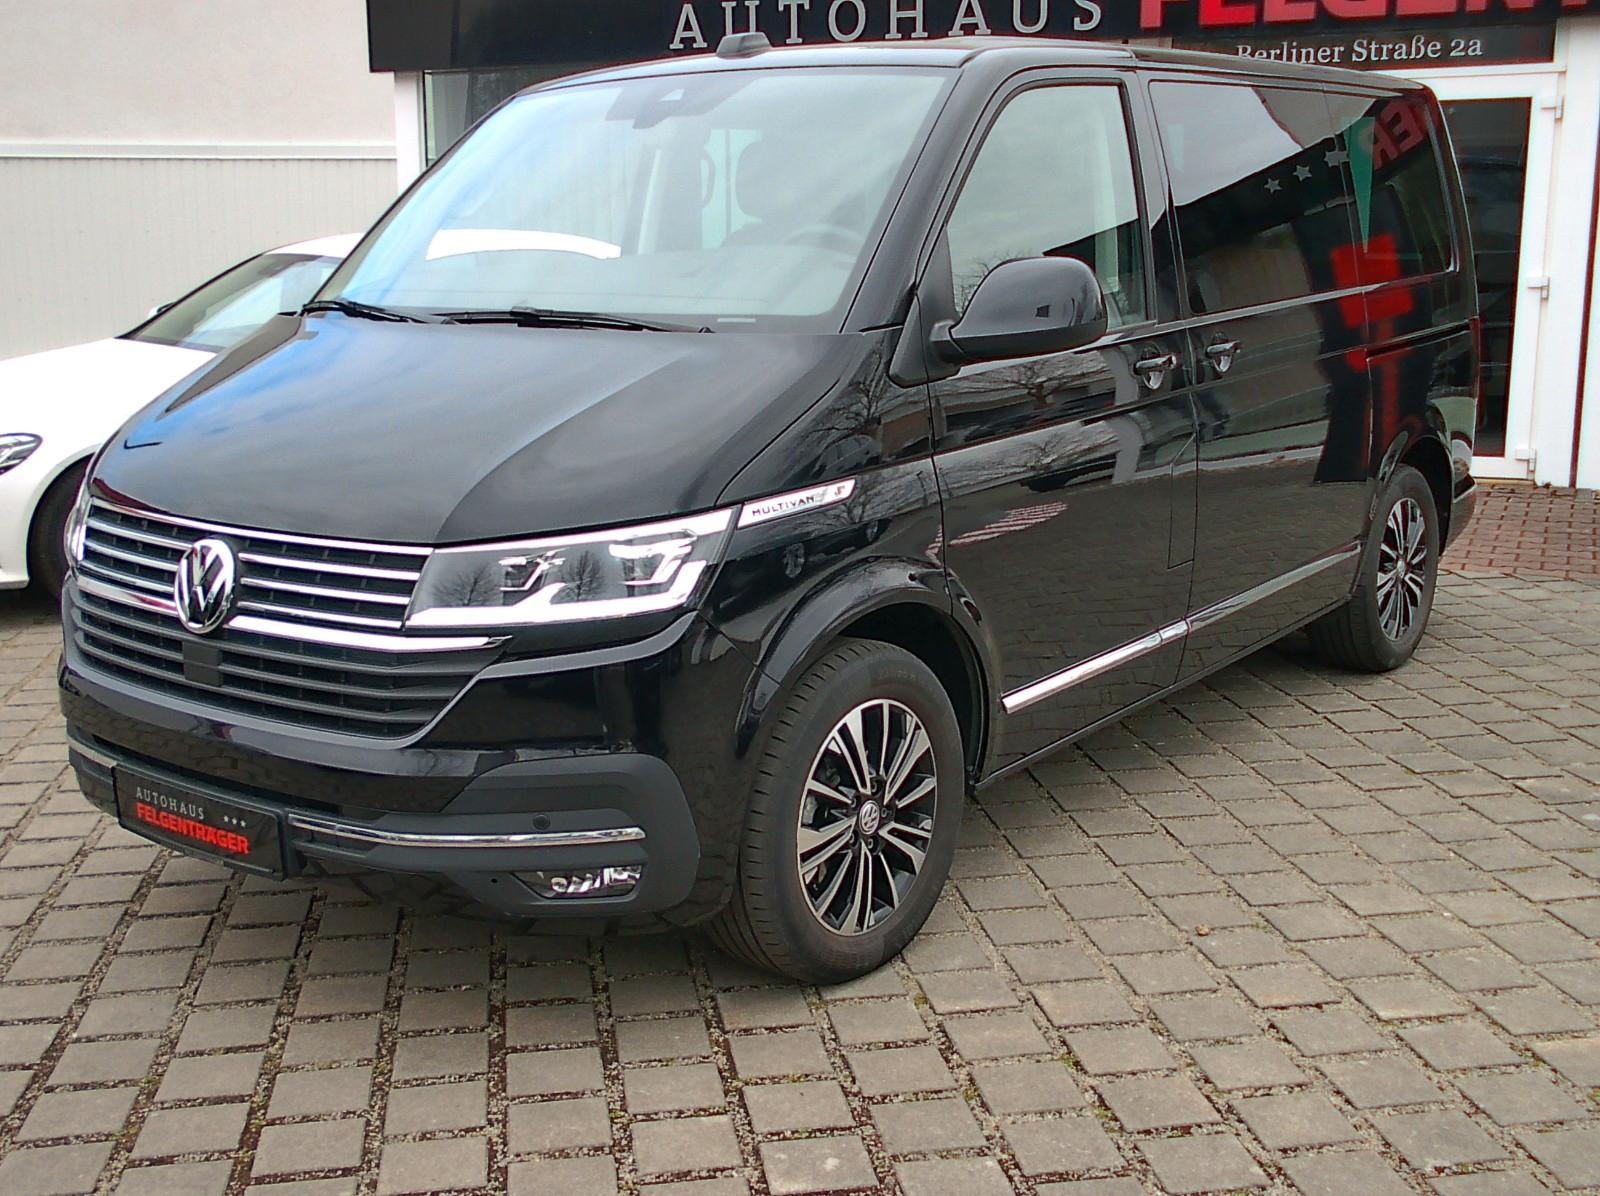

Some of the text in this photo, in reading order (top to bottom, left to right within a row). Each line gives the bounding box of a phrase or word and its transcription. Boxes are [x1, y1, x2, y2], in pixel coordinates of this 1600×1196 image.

[669, 0, 1102, 50] AUTOHAUS
[1352, 35, 1442, 62] Straße
[1450, 38, 1483, 56] 2a
[752, 496, 814, 517] MULTIVAN
[136, 786, 205, 820] AUTOHAUS
